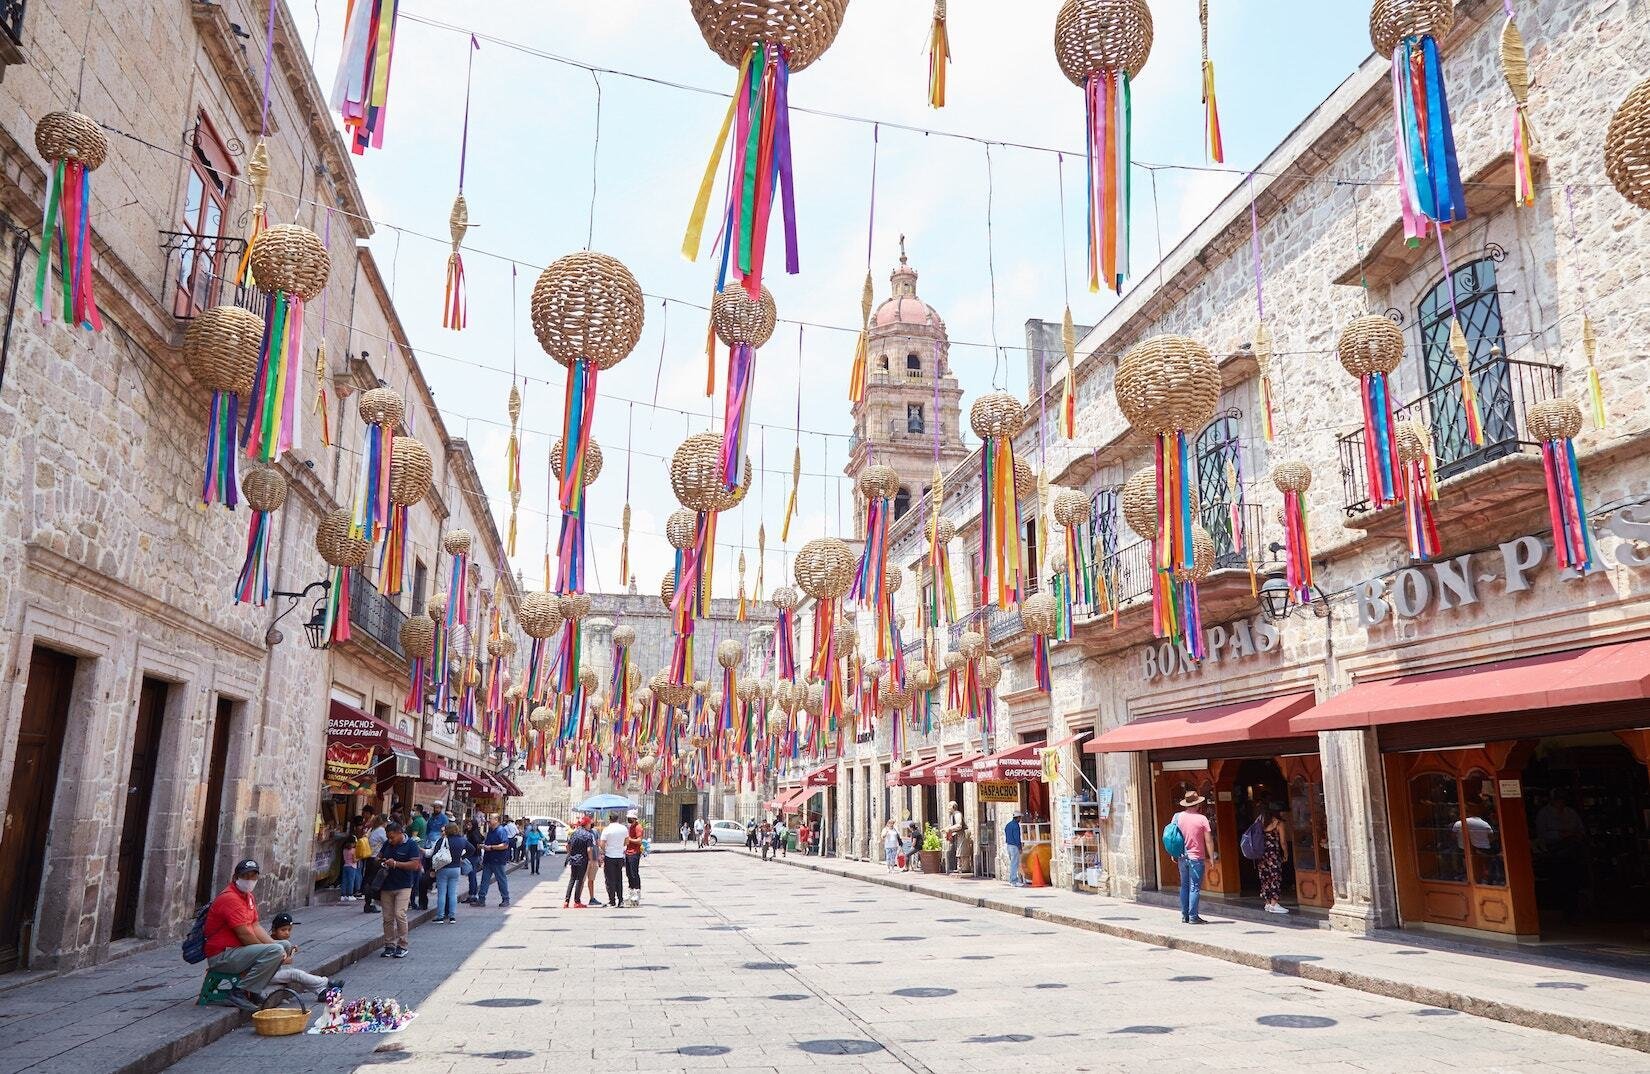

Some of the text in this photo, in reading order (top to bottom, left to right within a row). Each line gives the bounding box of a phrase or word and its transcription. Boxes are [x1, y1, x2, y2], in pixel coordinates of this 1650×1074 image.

[328, 719, 375, 728] GASPACHOS
[1005, 769, 1041, 777] GASPACHOS
[979, 784, 1018, 797] GASPACHOS
